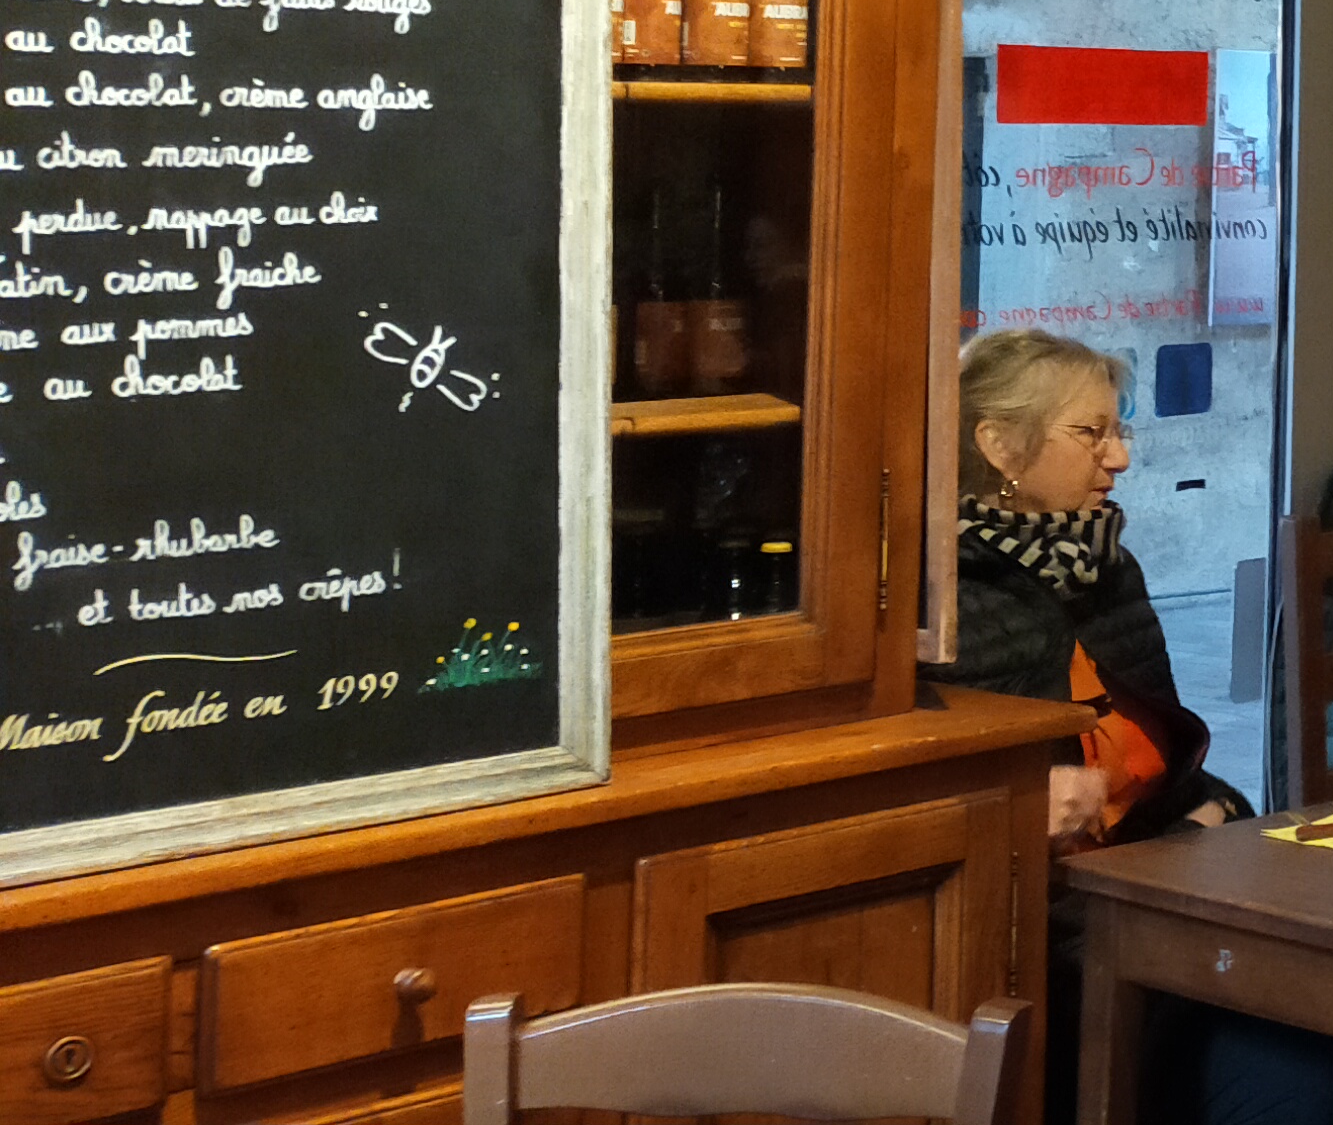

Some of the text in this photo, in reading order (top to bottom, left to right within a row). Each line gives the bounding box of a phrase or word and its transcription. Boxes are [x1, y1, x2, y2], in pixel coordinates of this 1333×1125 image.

[5, 16, 196, 57] au chocolat
[5, 86, 54, 107] au
[218, 78, 310, 109] crème
[316, 73, 433, 131] anglaise
[36, 130, 314, 189] citron meringuée
[141, 204, 267, 249] nappage
[274, 205, 315, 225] au
[319, 190, 379, 225] choix
[0, 255, 88, 304] atin,
[104, 258, 199, 295] crème
[60, 311, 254, 360] aux pommes
[43, 354, 243, 400] au chocolat
[77, 588, 114, 626] et
[129, 581, 217, 620] toutes
[222, 582, 284, 614] nos
[0, 671, 400, 762] Maison fondée en 1999
